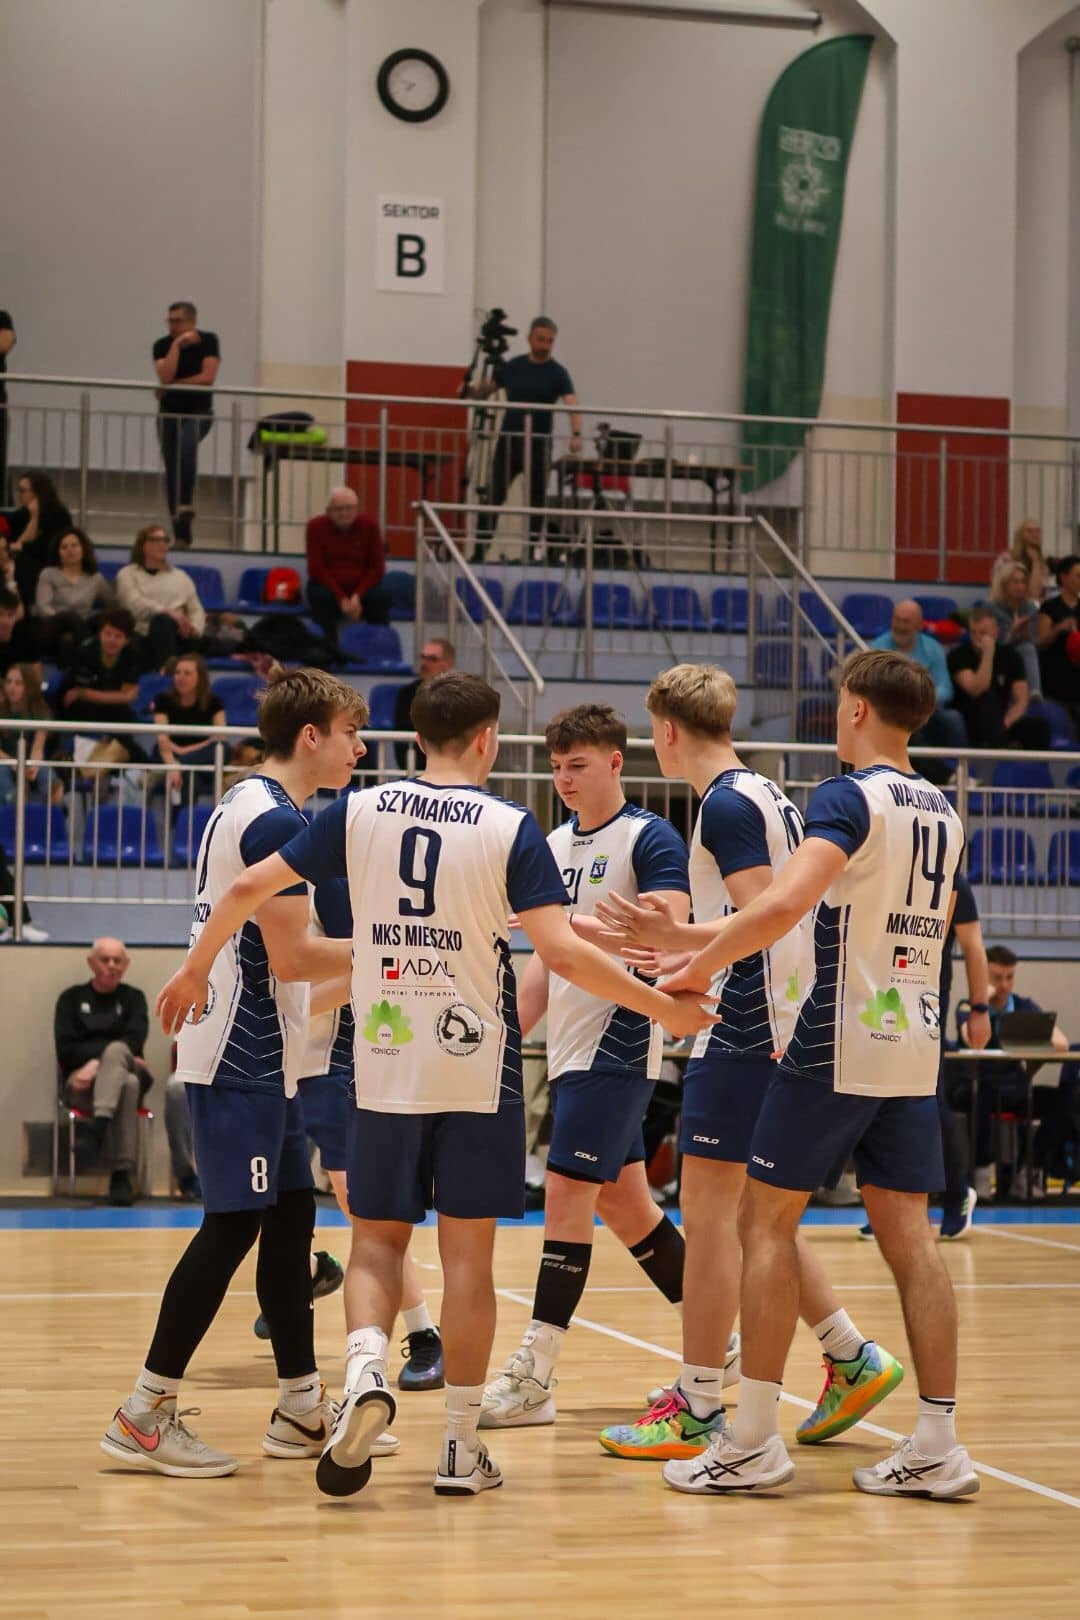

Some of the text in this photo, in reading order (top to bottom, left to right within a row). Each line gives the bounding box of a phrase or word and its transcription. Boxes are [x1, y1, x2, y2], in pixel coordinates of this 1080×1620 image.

[383, 203, 440, 220] SEKTOR
[397, 232, 427, 278] B
[377, 790, 483, 825] SZYMAŃSKI
[399, 826, 442, 917] 9
[906, 816, 947, 910] 14
[372, 923, 462, 952] MKS MIESZKO
[402, 958, 455, 978] ADAL
[693, 1135, 720, 1145] COLO
[574, 1151, 598, 1162] COLO
[752, 1155, 775, 1169] COLO
[250, 1156, 268, 1193] 8
